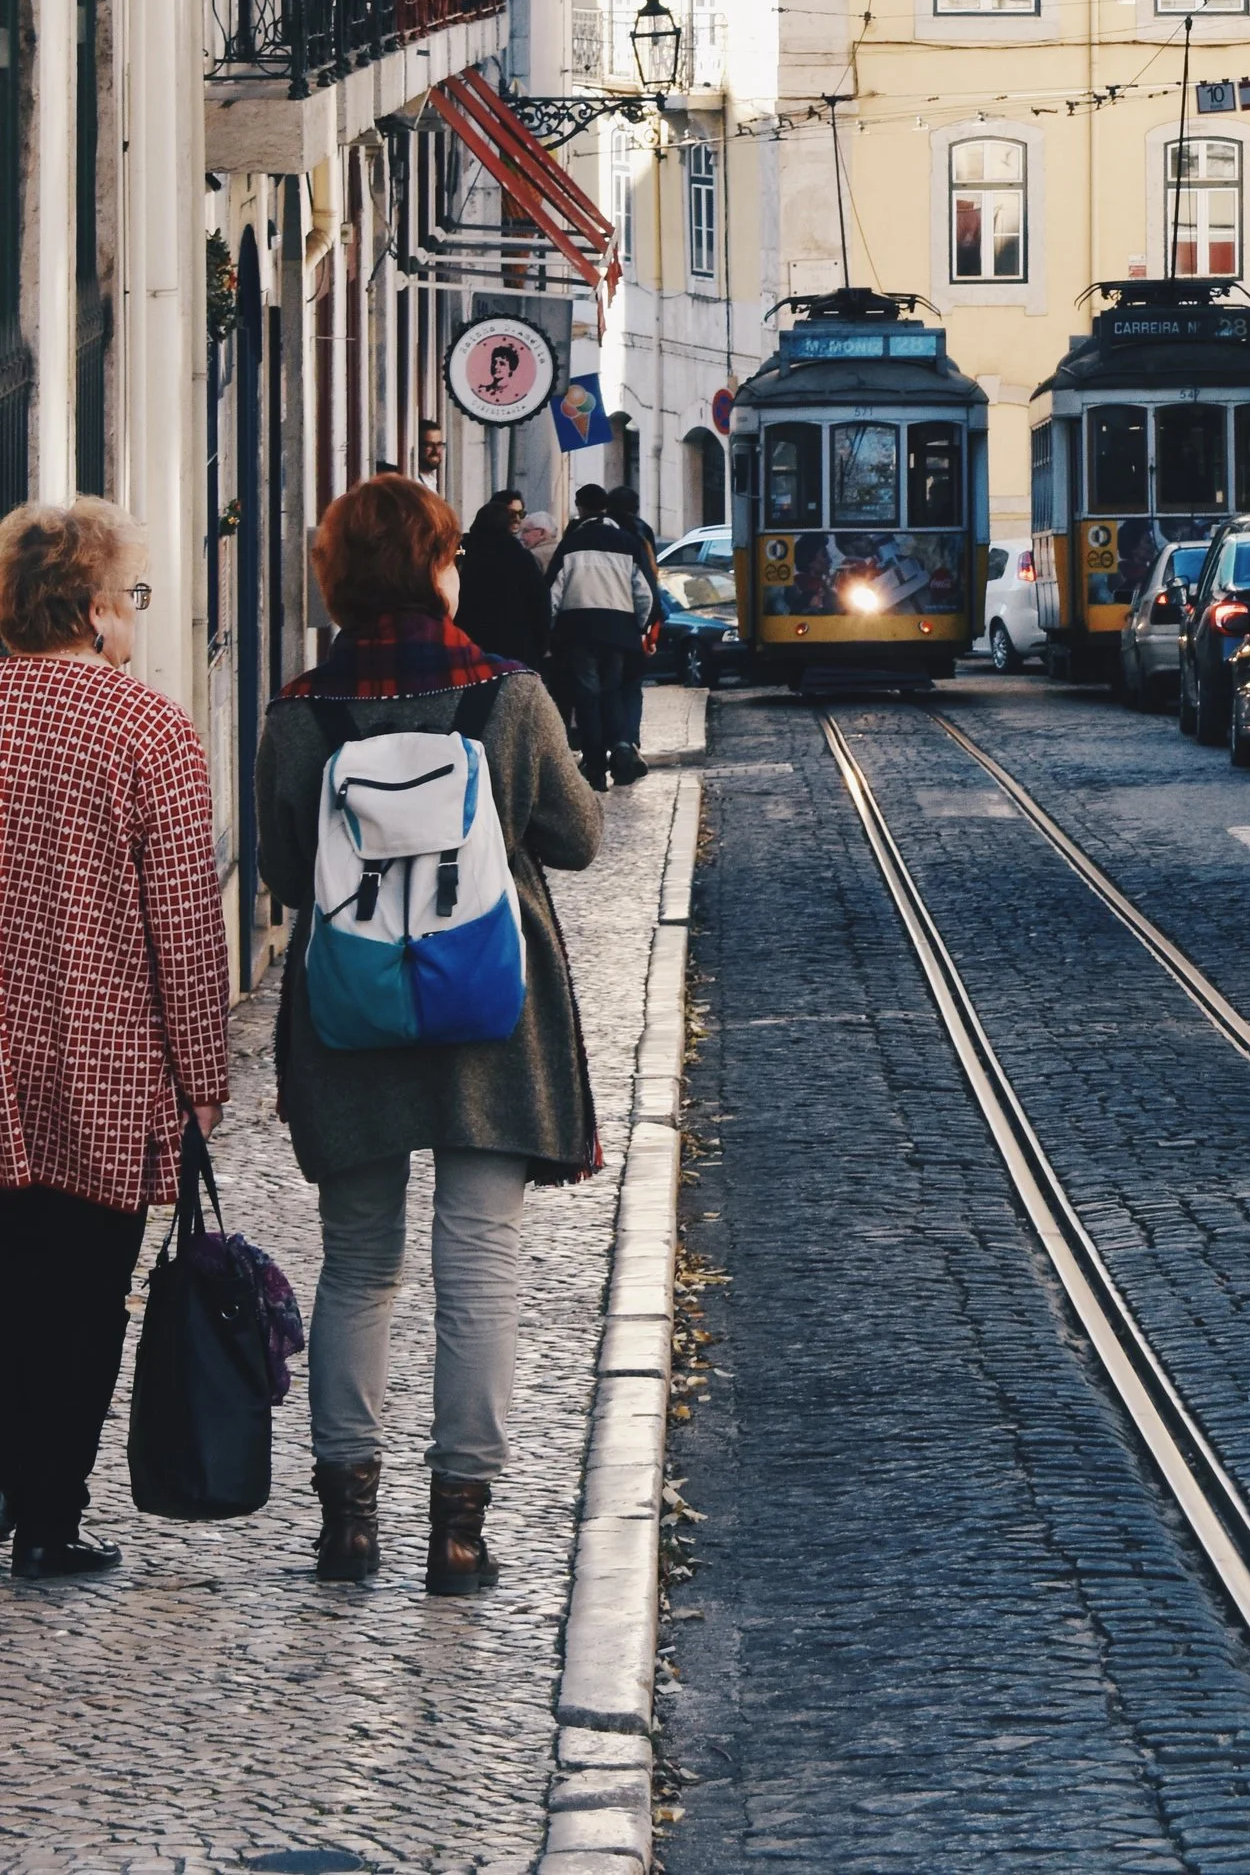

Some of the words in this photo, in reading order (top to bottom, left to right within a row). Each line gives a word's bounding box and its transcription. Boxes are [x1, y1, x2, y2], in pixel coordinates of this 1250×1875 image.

[1206, 86, 1225, 103] 10
[1114, 321, 1180, 335] CARREIRA
[1219, 317, 1248, 337] 28
[828, 339, 882, 353] MONIZ
[896, 336, 923, 352] 28
